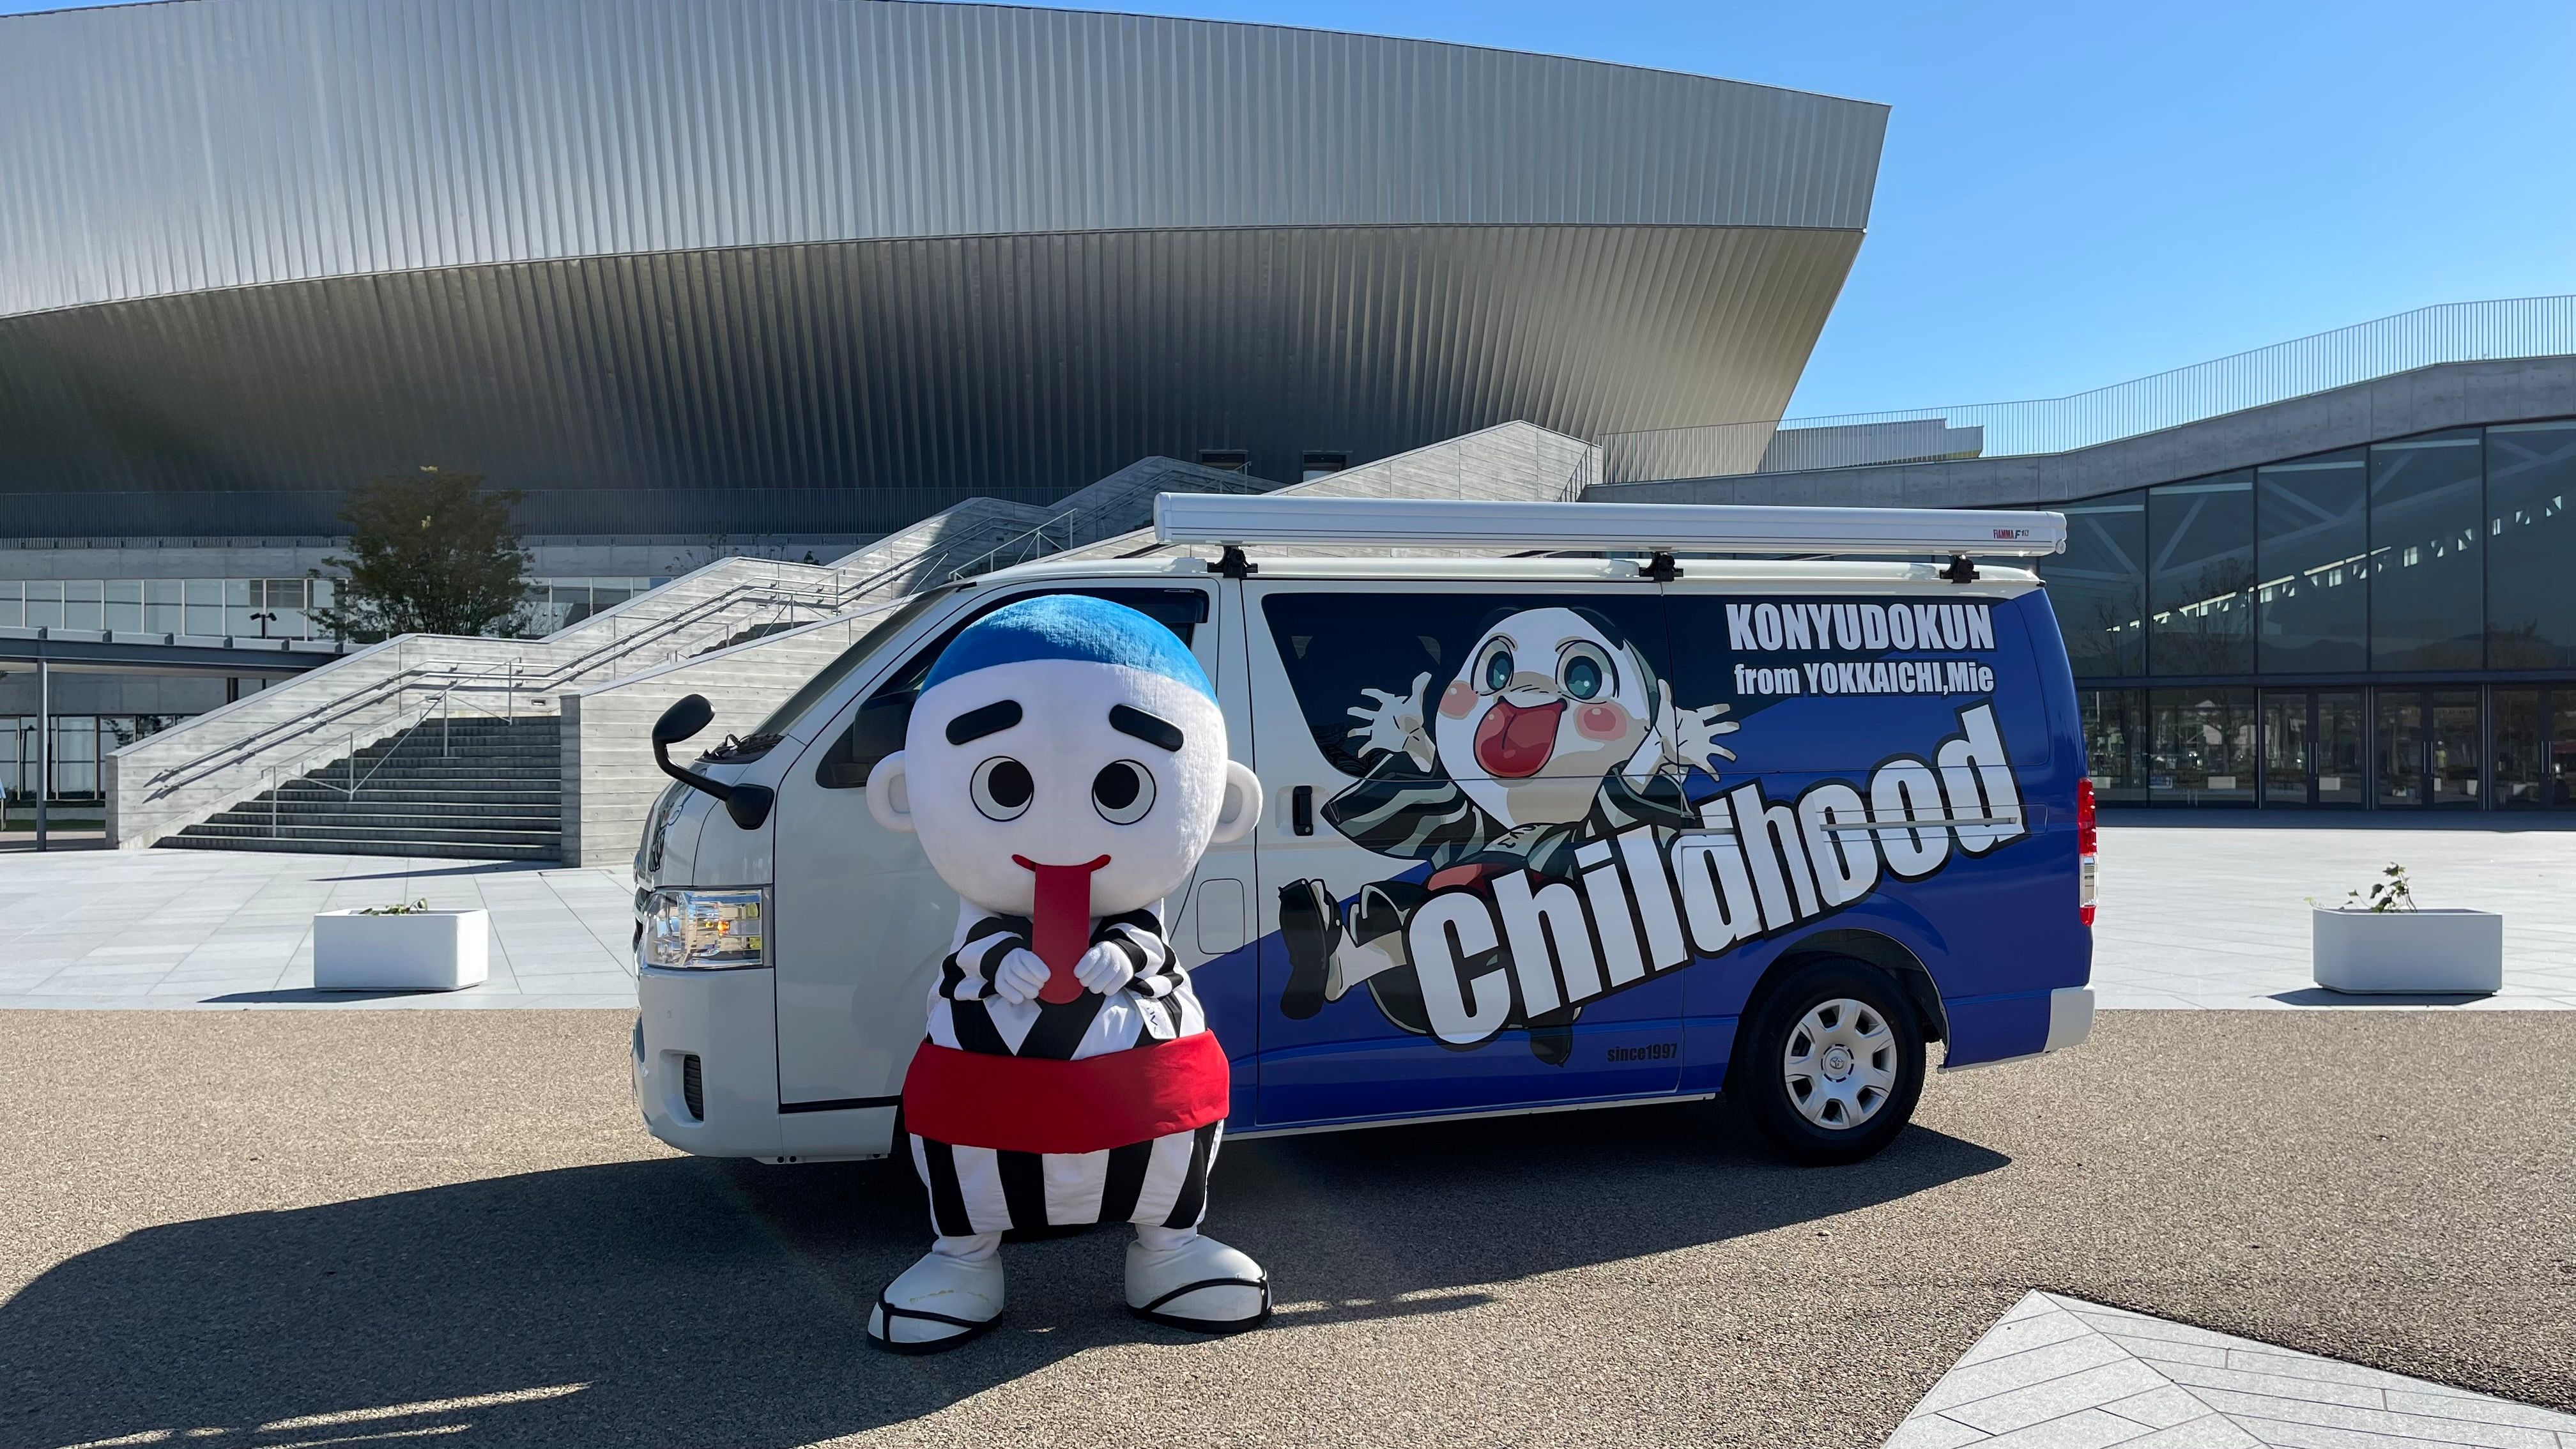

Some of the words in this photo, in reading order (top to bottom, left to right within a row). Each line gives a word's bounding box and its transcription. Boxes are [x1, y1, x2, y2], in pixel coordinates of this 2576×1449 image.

[1993, 529, 2014, 539] FIAMMA
[1726, 602, 1995, 650] KONYUDOKUN
[1734, 663, 1800, 695] from
[1607, 1043, 1678, 1062] since1997
